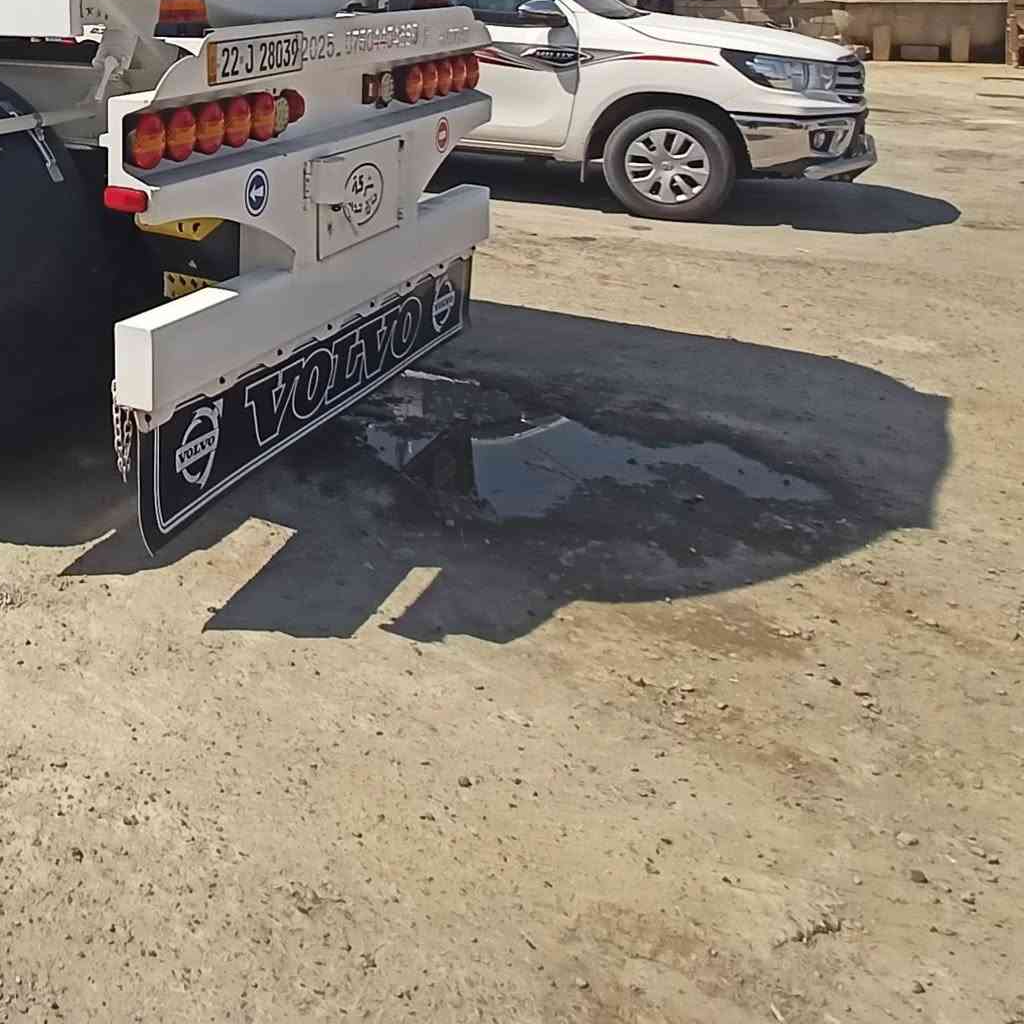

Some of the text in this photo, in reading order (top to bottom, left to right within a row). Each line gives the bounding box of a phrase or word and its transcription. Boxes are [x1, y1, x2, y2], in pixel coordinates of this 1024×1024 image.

[221, 38, 299, 78] 22 J 28039
[244, 297, 422, 447] VOLVO
[178, 435, 216, 464] VOLVO
